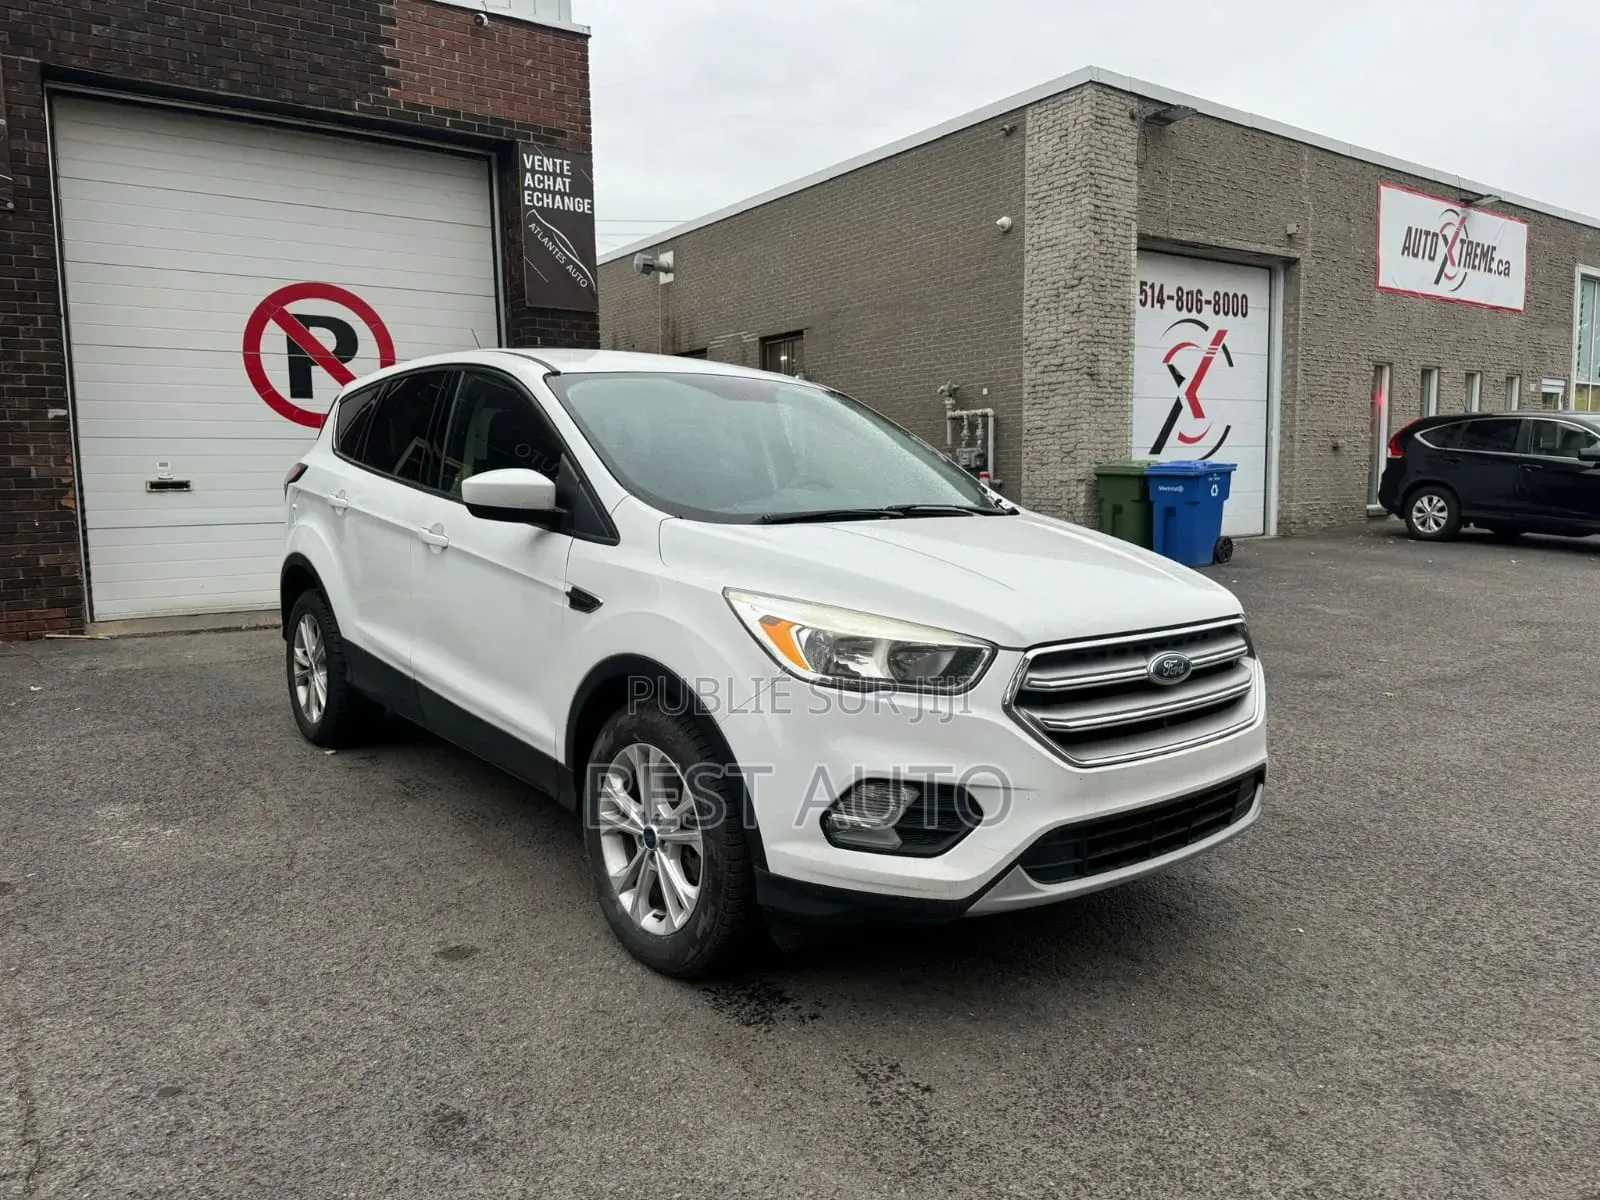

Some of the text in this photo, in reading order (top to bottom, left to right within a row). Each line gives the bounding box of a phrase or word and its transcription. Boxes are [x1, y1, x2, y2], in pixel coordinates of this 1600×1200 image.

[523, 153, 572, 176] VENTE
[524, 172, 572, 193] ACHAT
[524, 190, 592, 213] ECHANGE
[527, 222, 588, 289] ATLANTES AUTO
[1139, 280, 1248, 319] 514-806-8000
[1163, 659, 1184, 677] Ford
